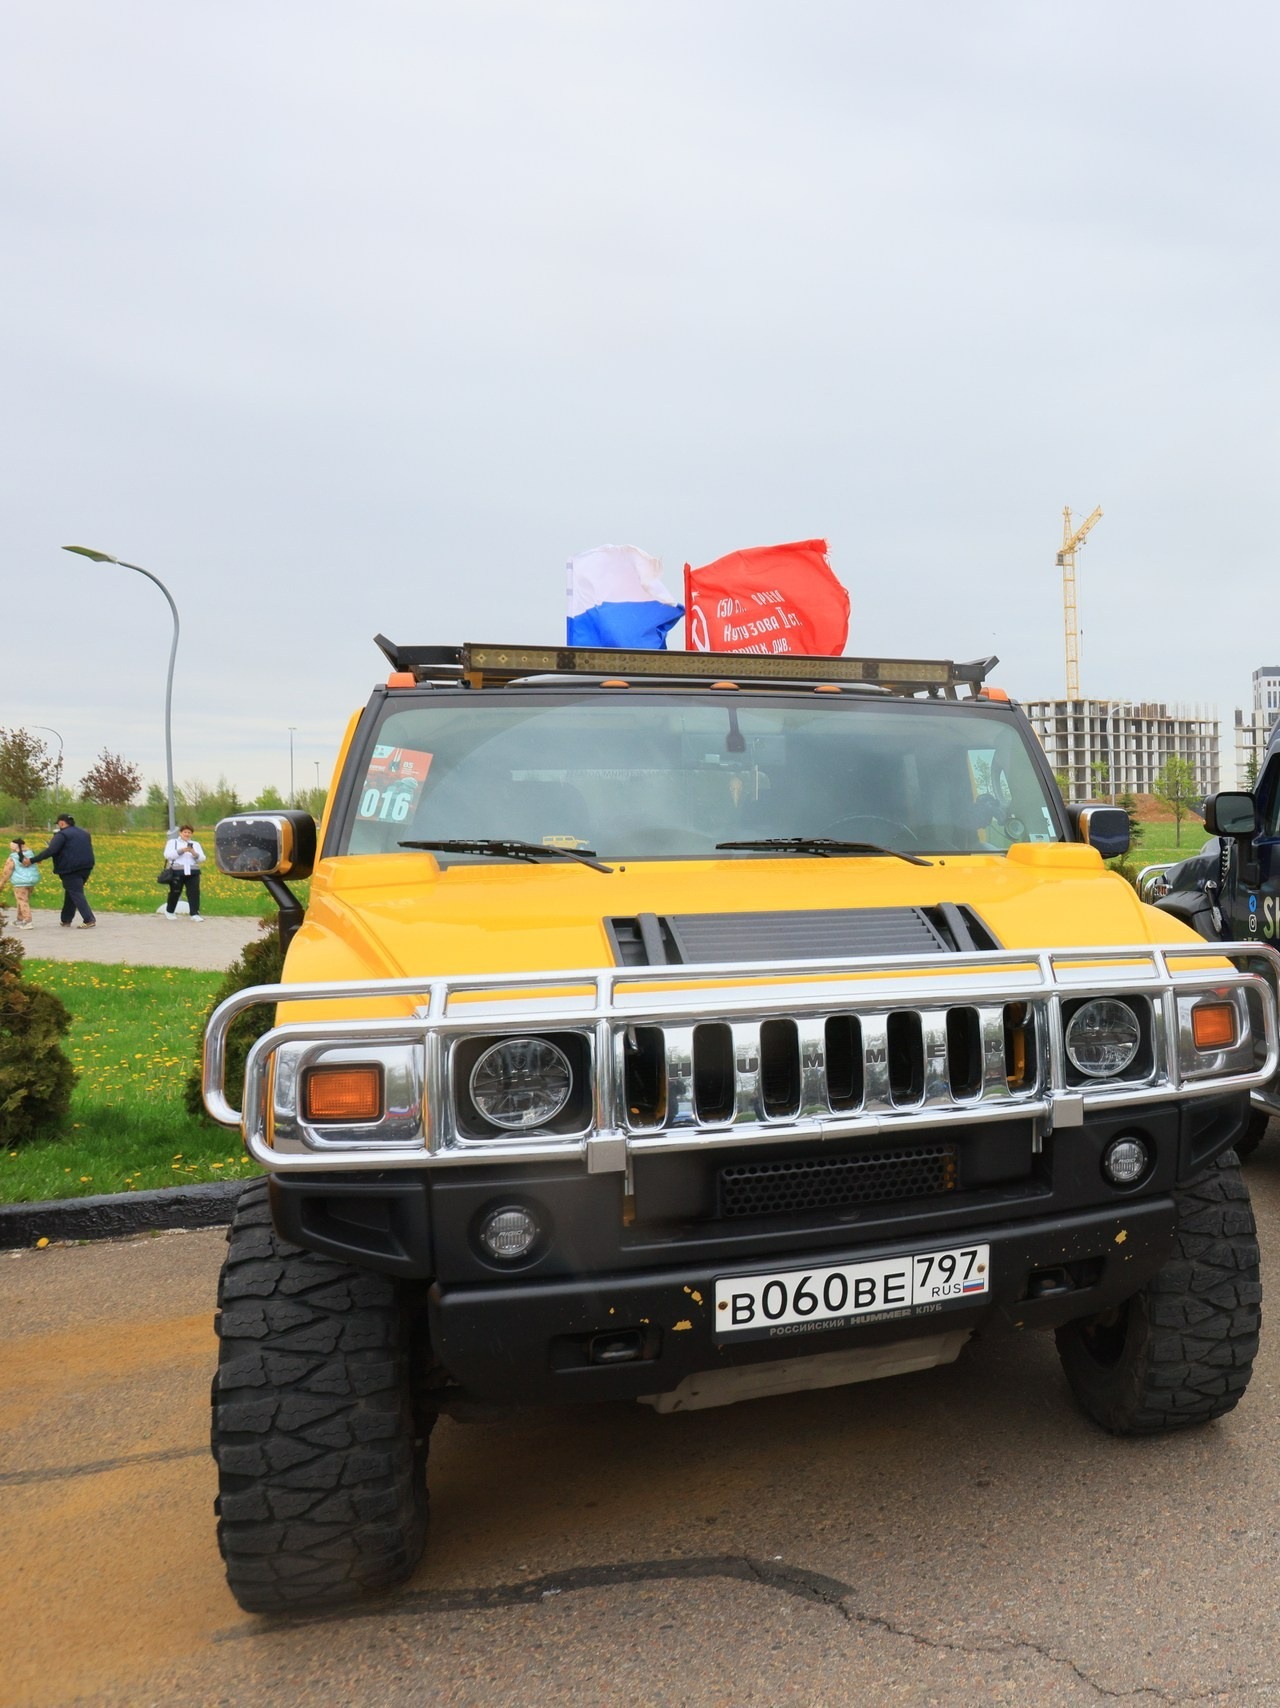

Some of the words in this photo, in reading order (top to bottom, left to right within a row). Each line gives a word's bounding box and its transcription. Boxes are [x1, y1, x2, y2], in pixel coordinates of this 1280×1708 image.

[360, 788, 412, 821] 016
[731, 1271, 906, 1325] В060ВЕ
[916, 1249, 978, 1288] 797
[931, 1283, 961, 1298] RUS
[769, 1318, 845, 1336] РОССИЙСКИЙ
[850, 1307, 912, 1325] HUMMER
[915, 1303, 943, 1315] КЛУБ
